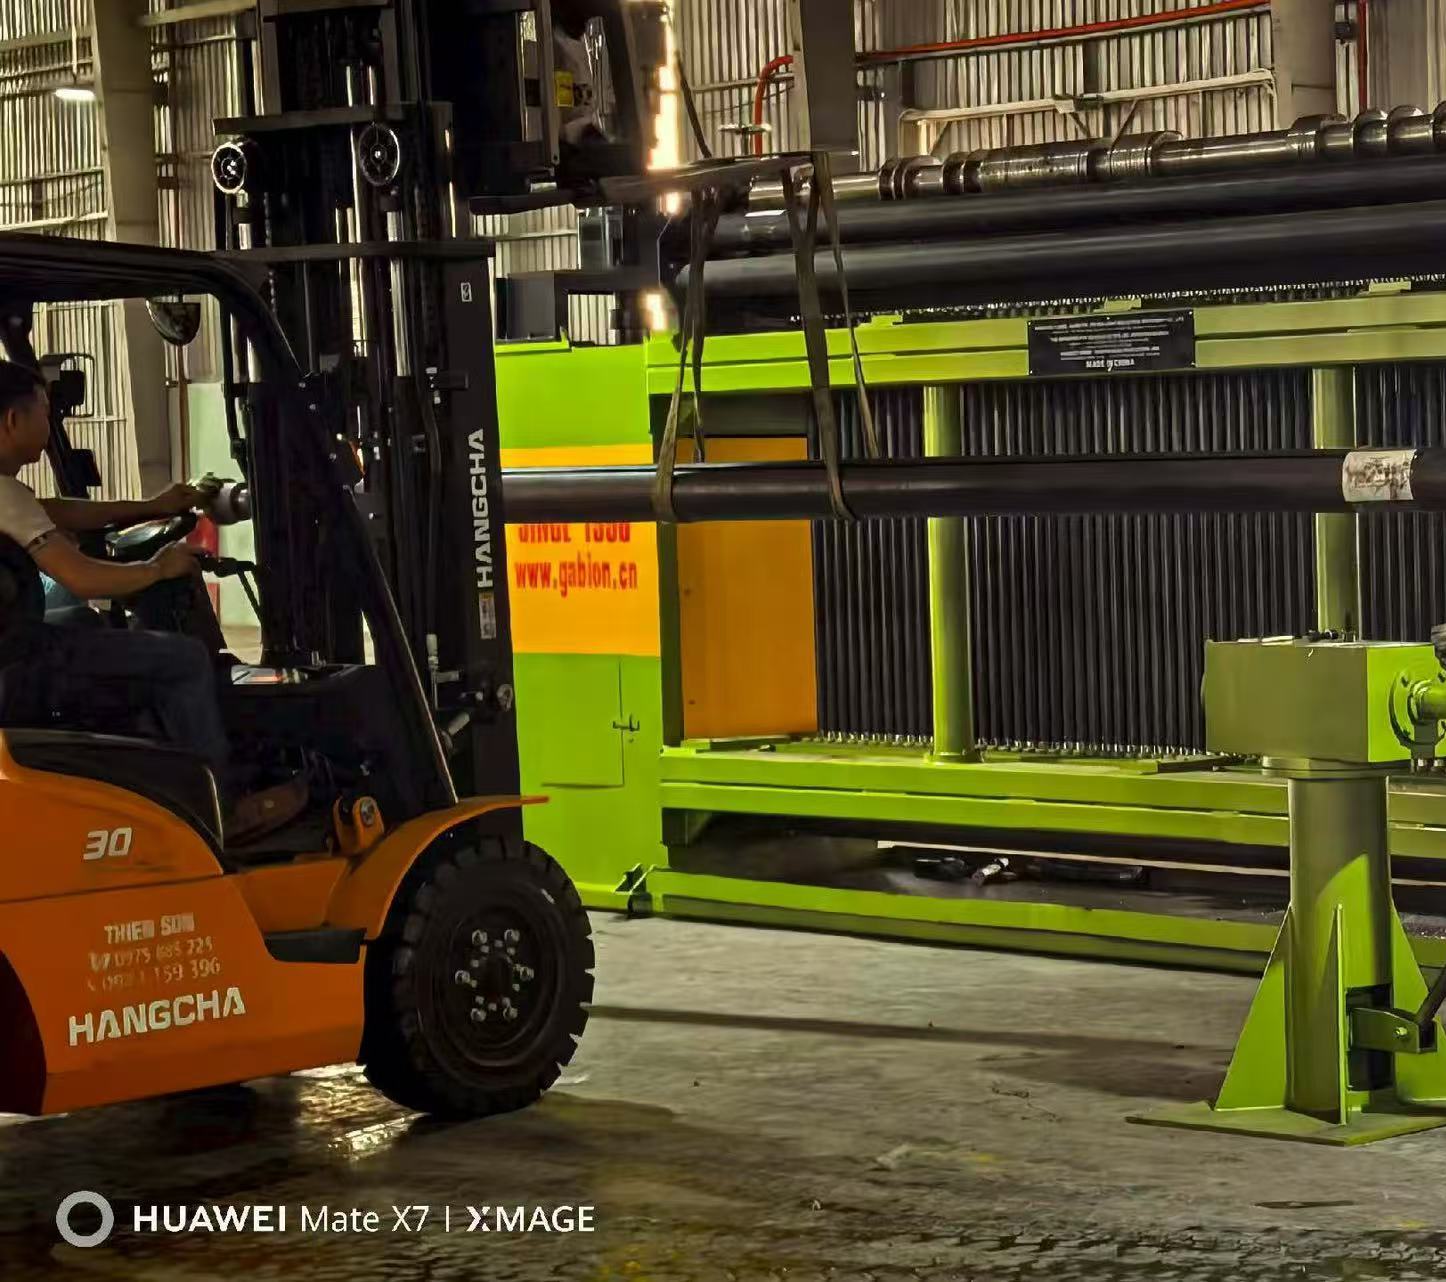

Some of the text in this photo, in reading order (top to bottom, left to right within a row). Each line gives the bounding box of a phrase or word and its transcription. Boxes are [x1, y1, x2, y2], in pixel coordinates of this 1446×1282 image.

[468, 428, 494, 588] HANGCHA
[514, 551, 638, 599] www.gabion.cn
[83, 827, 133, 860] 30
[68, 987, 246, 1047] HANGCHA
